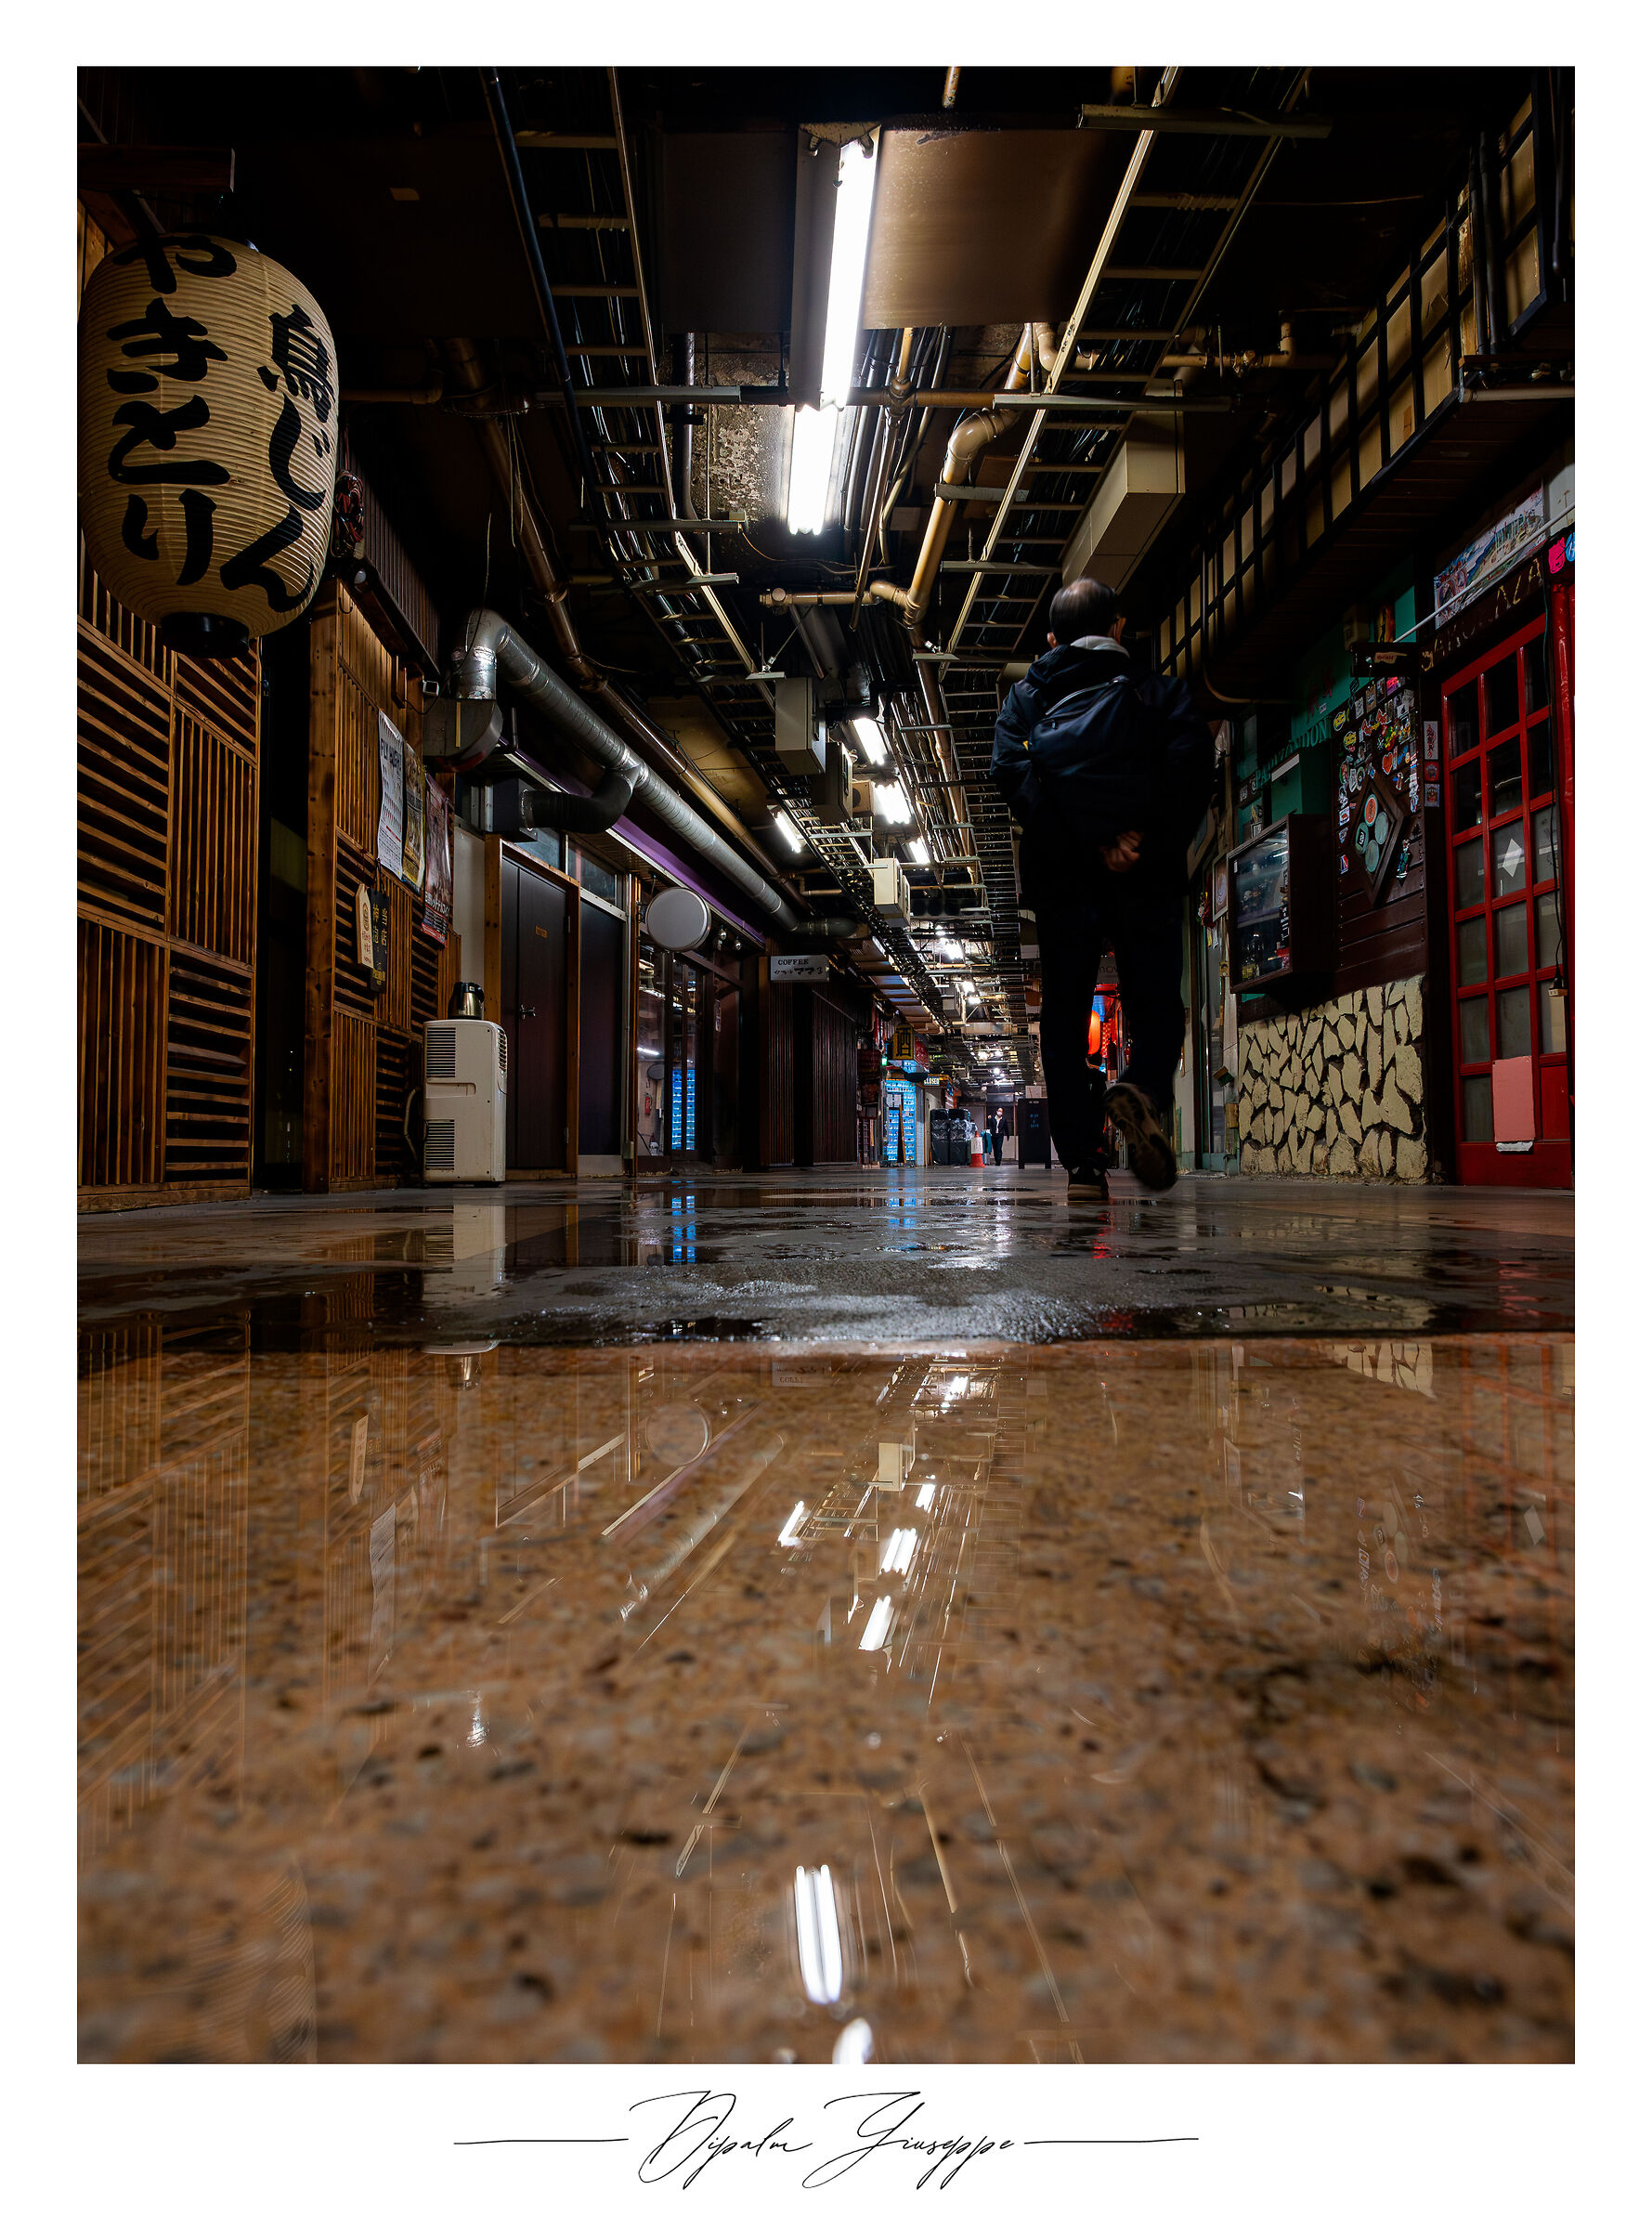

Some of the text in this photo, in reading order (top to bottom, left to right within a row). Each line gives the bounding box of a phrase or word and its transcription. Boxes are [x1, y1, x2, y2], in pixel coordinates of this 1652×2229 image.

[106, 232, 237, 587] やきとり
[220, 303, 338, 611] 鳥じん
[895, 1027, 912, 1057] 酒
